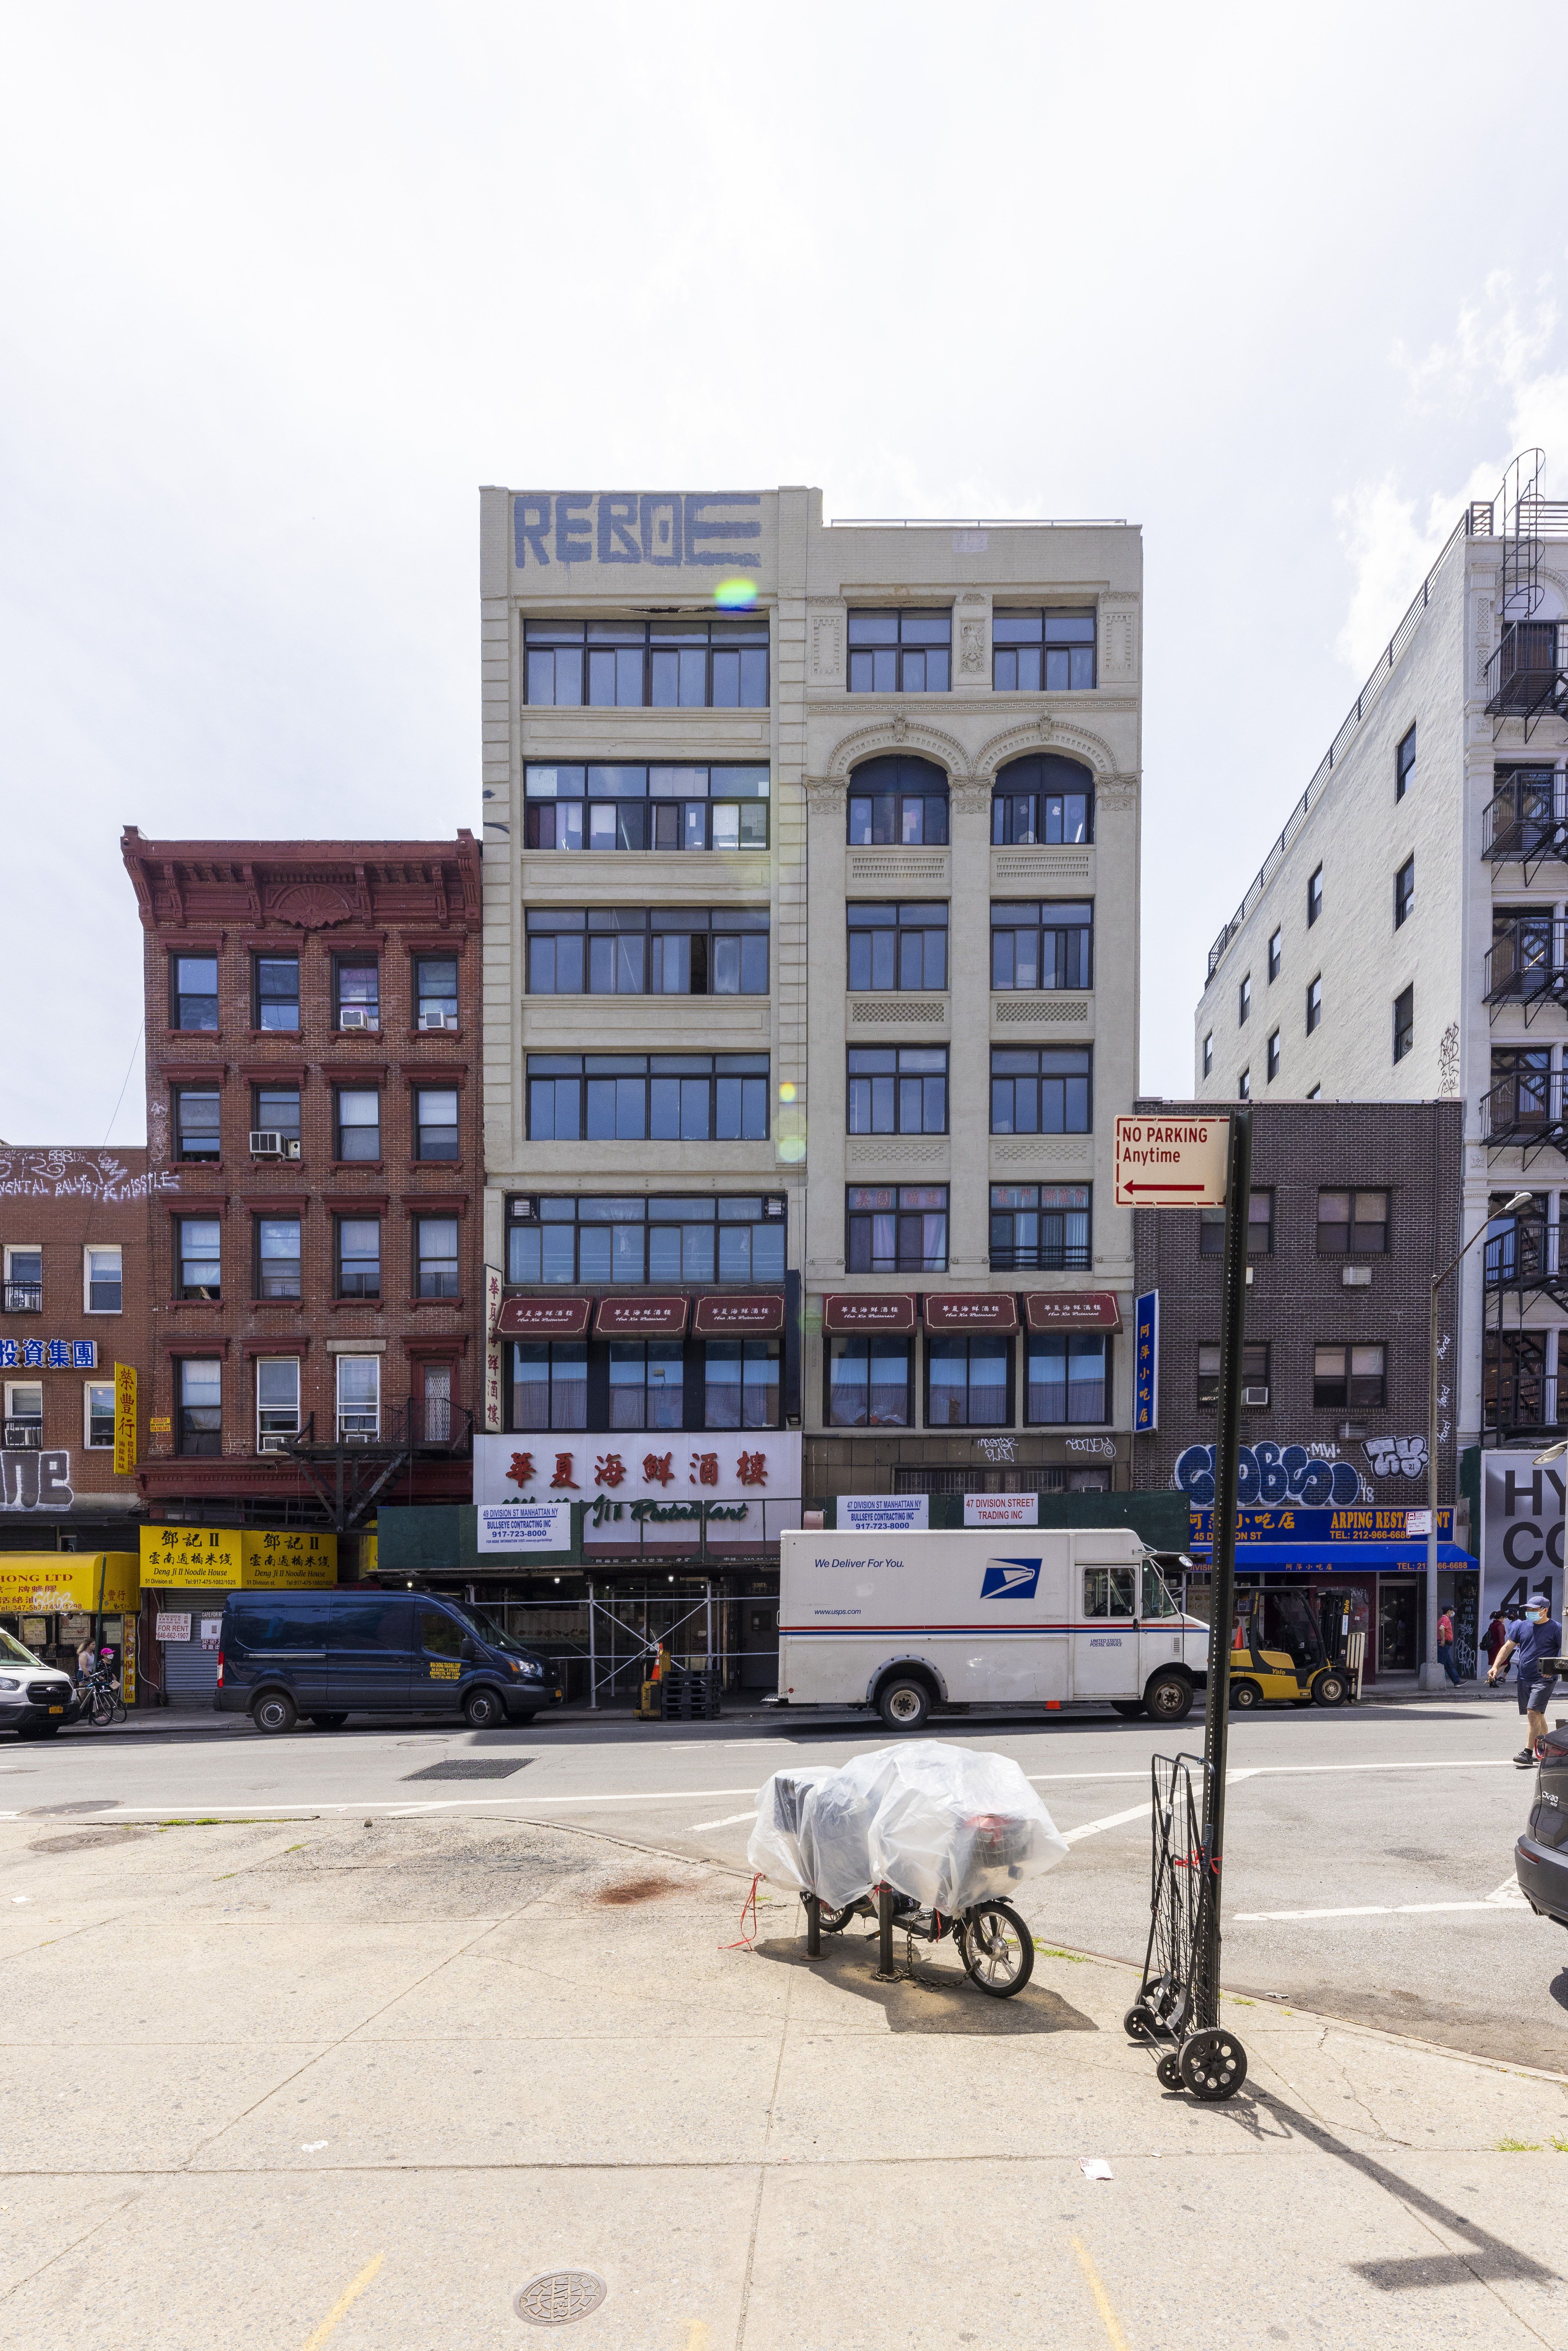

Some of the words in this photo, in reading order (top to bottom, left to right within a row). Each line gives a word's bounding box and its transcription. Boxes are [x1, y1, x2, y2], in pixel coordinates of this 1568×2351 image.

[1123, 1127, 1141, 1142] NO
[1147, 1127, 1207, 1143] PARKING
[1123, 1147, 1180, 1166] Anytime
[0, 1339, 94, 1368] 投資集團
[1139, 1324, 1150, 1422] 阿萍小吃店
[118, 1368, 135, 1439] 榮豐行
[506, 1451, 768, 1488] 華夏海鮮酒樓
[883, 1500, 914, 1508] MANHATTAN
[966, 1499, 974, 1508] 47
[976, 1499, 1006, 1508] DIVISION
[1008, 1498, 1034, 1507] STREET
[874, 1512, 905, 1521] CONTRACTING
[978, 1511, 1009, 1520] TRADING
[1011, 1511, 1022, 1519] INC
[1331, 1512, 1373, 1528] ARPING
[511, 1520, 542, 1528] CONTRACTING
[162, 1530, 202, 1549] 鄧記
[210, 1533, 219, 1546] II
[264, 1533, 303, 1551] 鄧記
[310, 1537, 319, 1550] II
[815, 1559, 830, 1567] We
[832, 1559, 866, 1567] Deliver
[867, 1559, 884, 1567] For
[885, 1559, 904, 1567] You.
[153, 1568, 170, 1576] Deng
[255, 1570, 271, 1578] Deng
[1542, 1791, 1559, 1803] CX-30
[553, 2277, 568, 2318] WATER
